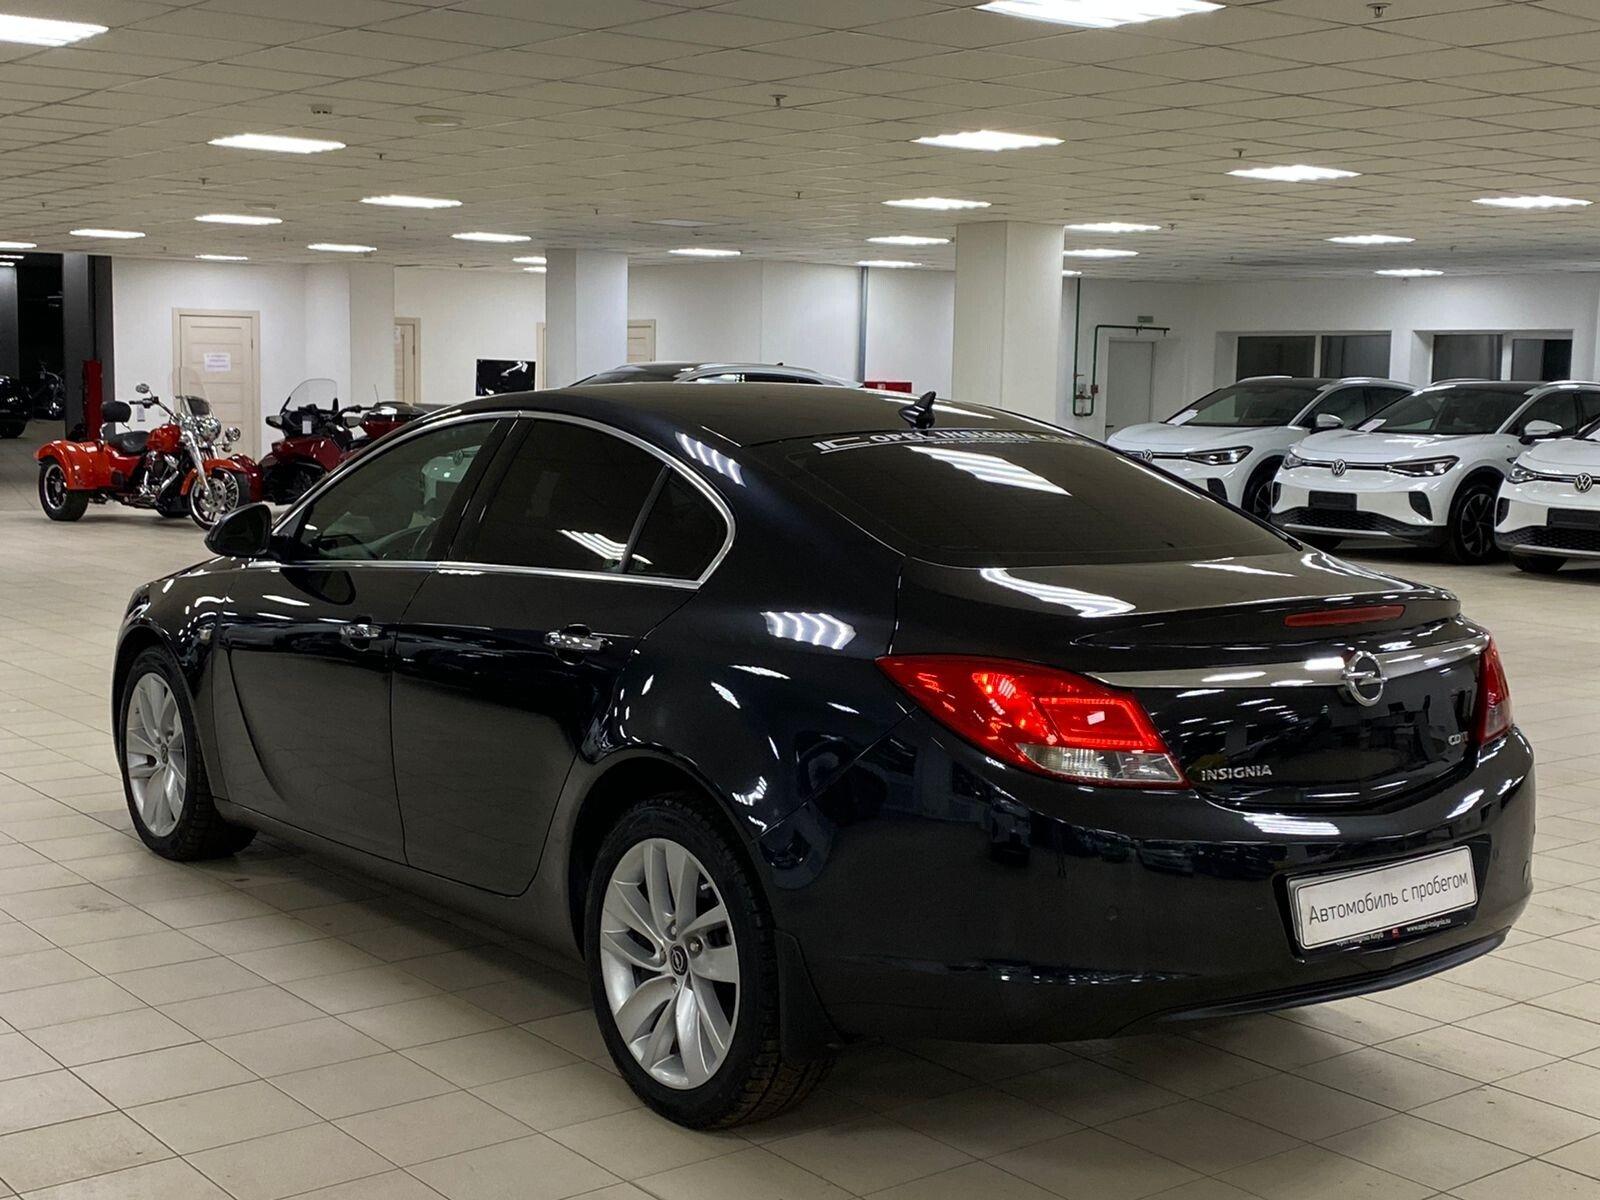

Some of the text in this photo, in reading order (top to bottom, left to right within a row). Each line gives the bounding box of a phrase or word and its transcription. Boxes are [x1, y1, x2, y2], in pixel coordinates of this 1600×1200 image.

[1201, 764, 1273, 782] INSIGNIA
[1309, 872, 1468, 925] Автомобиль с пробегом
